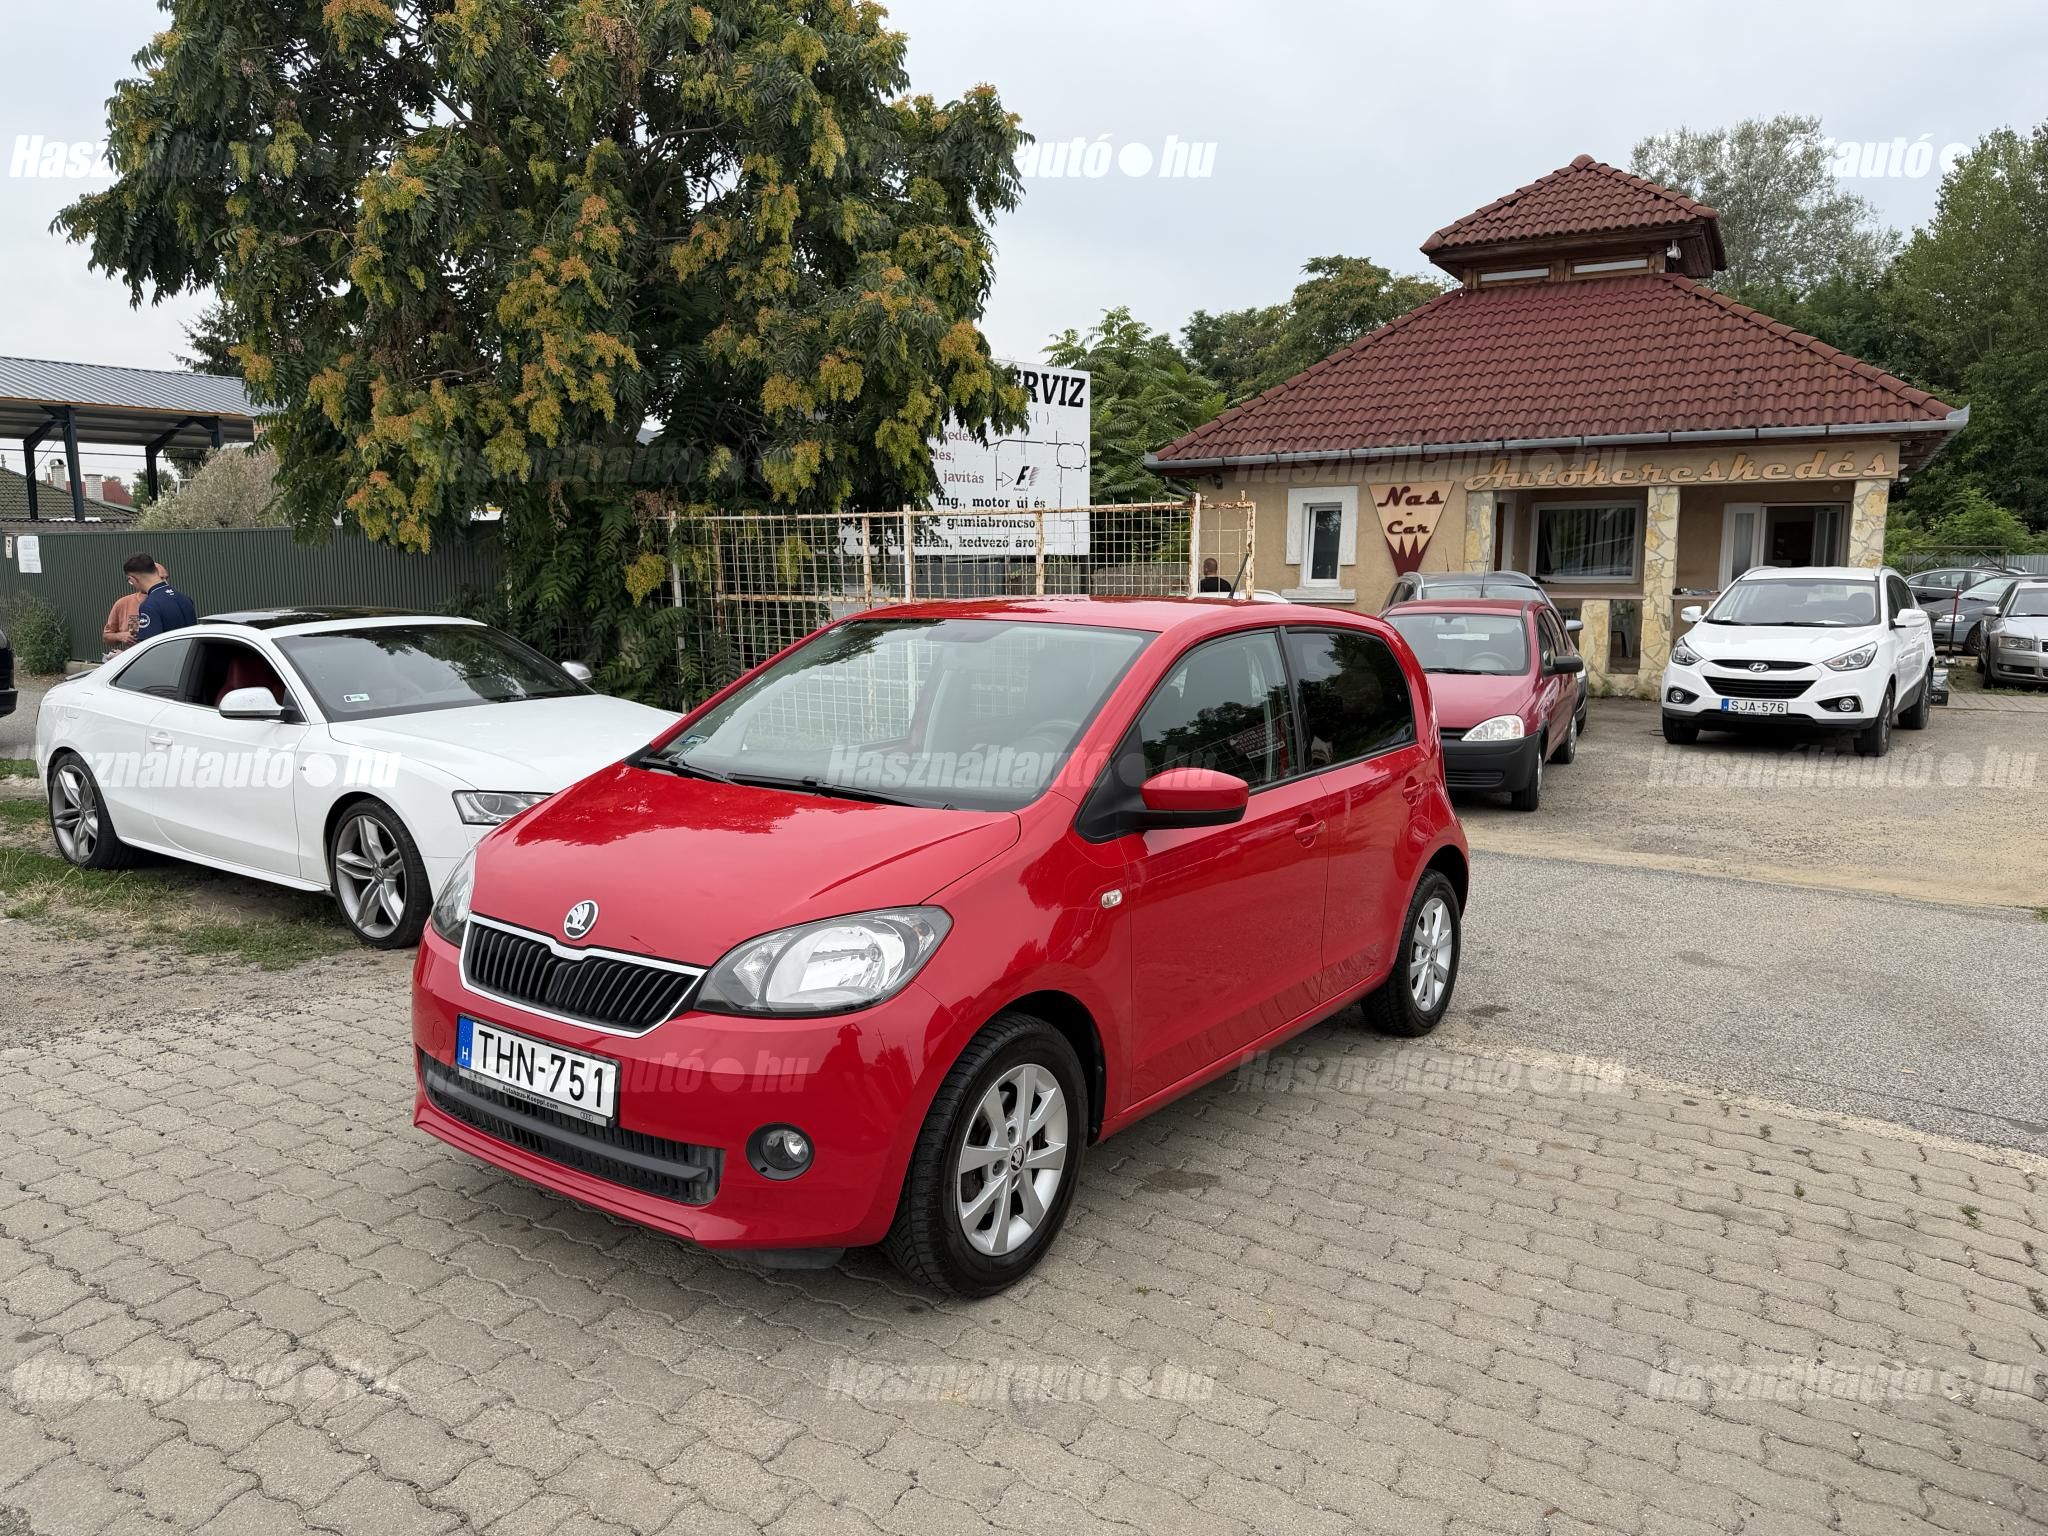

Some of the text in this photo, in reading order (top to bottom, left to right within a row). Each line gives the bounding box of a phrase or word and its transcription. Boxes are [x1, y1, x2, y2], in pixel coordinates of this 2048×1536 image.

[1464, 450, 1893, 491] Autókereskedés
[972, 497, 1010, 508] motor
[1377, 486, 1444, 507] Nas
[947, 516, 1035, 529] gumiabroncso
[1387, 520, 1430, 534] Car
[959, 536, 1009, 548] kedvező
[1731, 701, 1784, 713] SJA-576
[461, 1030, 603, 1107] H THN-751
